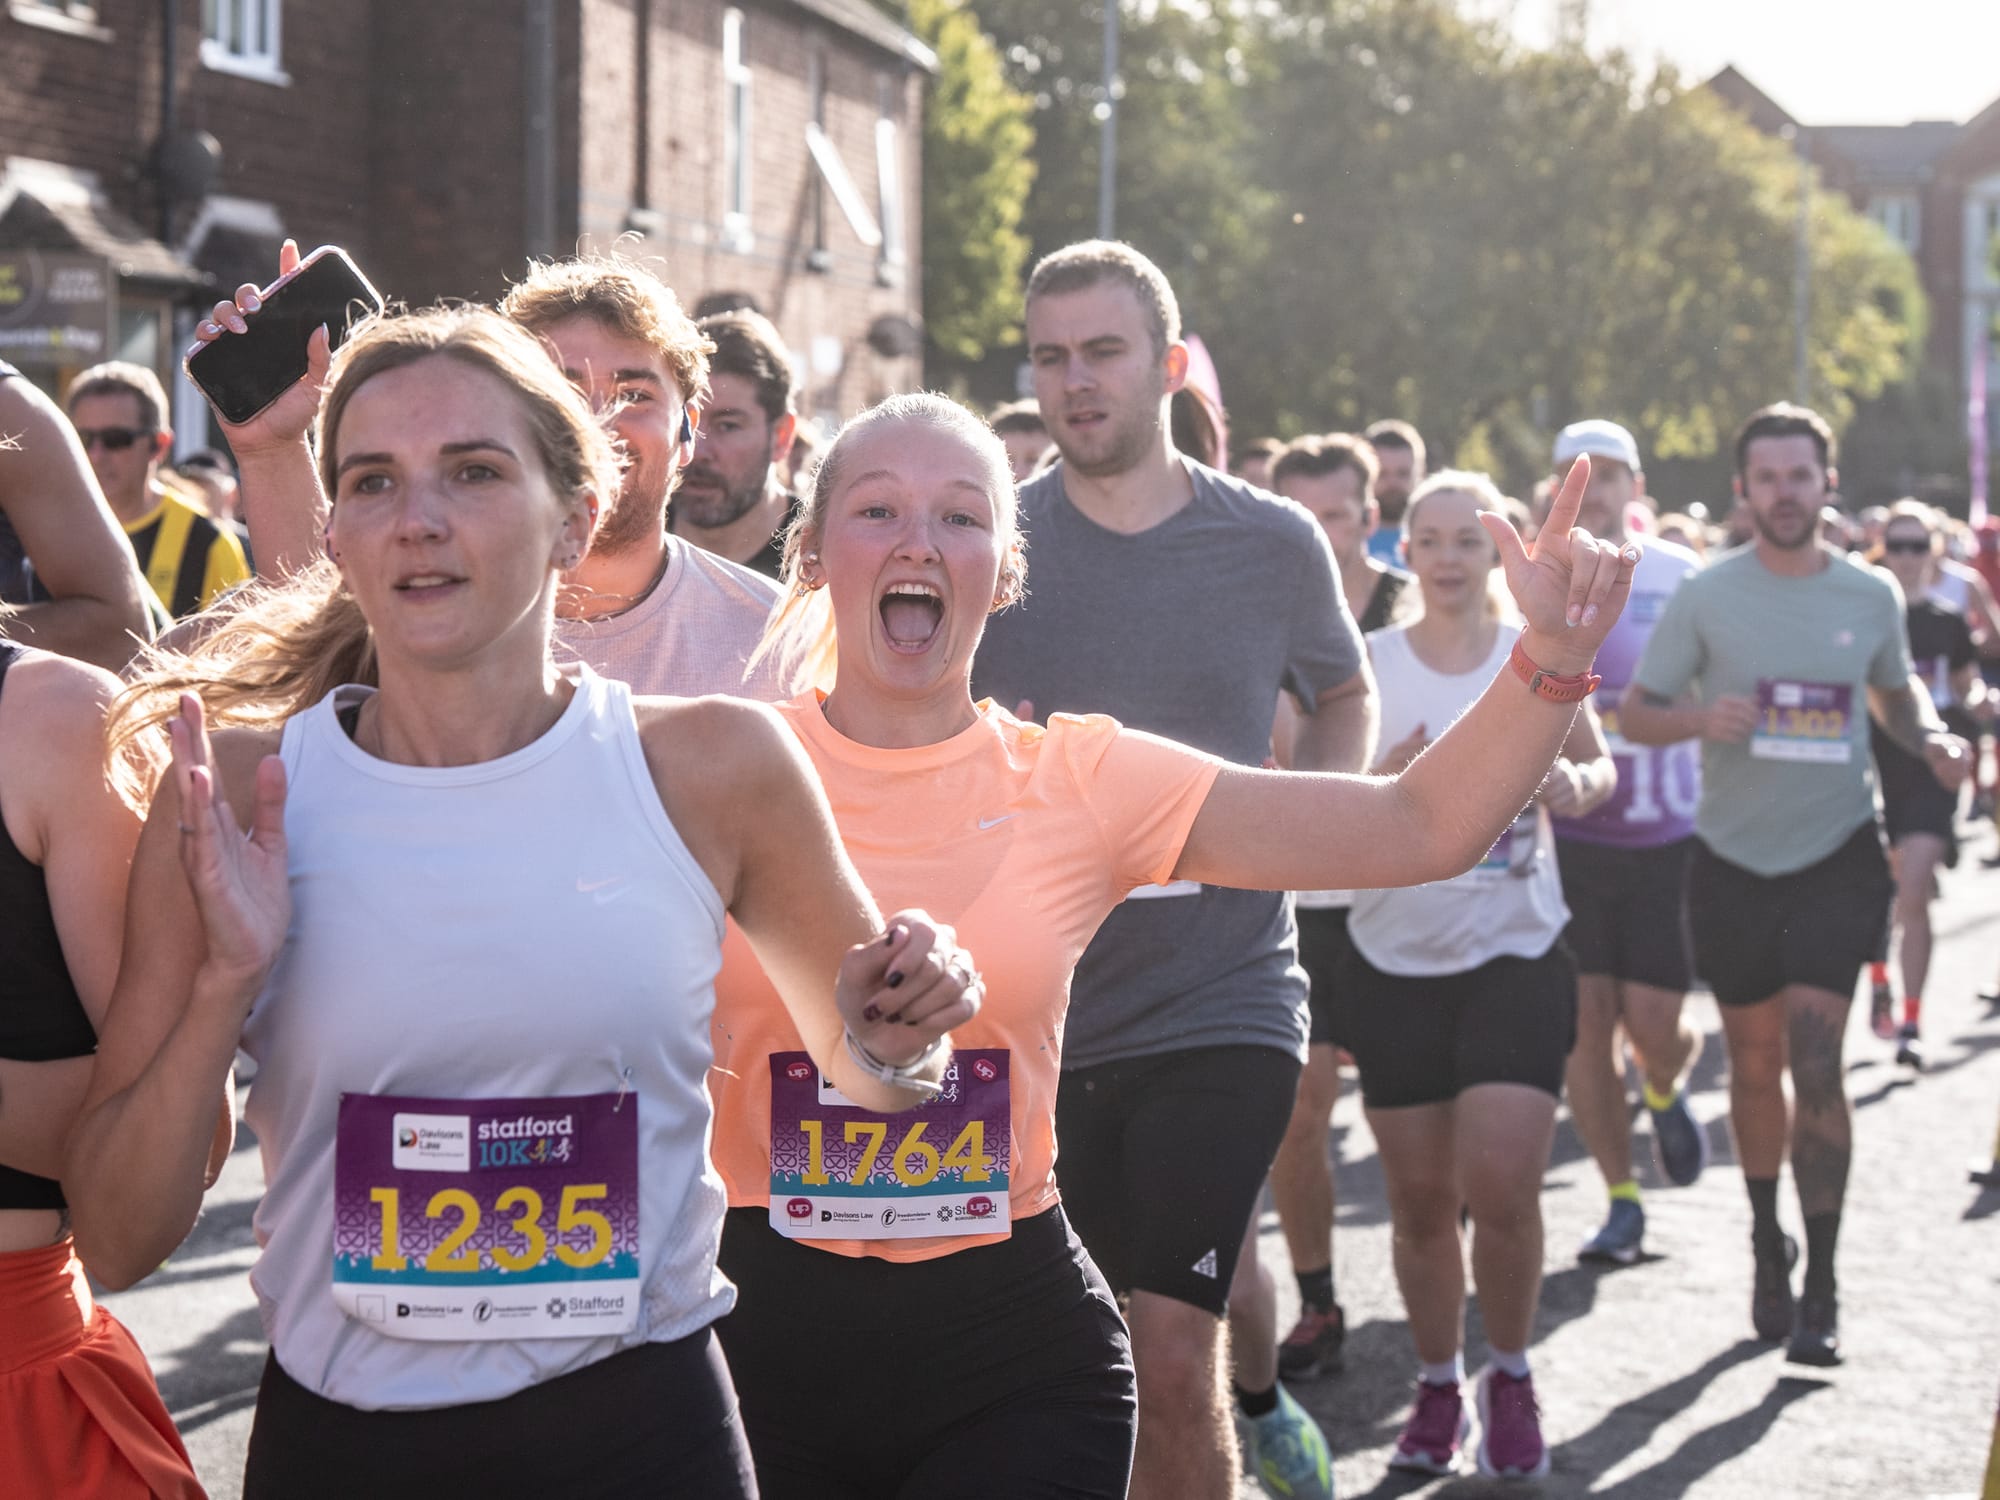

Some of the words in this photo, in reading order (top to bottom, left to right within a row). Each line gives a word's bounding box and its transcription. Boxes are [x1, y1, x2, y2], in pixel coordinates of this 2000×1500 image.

[419, 1128, 464, 1139] Davisons
[477, 1115, 573, 1139] stafford
[419, 1141, 441, 1150] Law
[479, 1140, 531, 1166] 10K
[800, 1120, 992, 1187] 1764
[369, 1183, 613, 1273] 1235
[569, 1296, 624, 1310] Stafford
